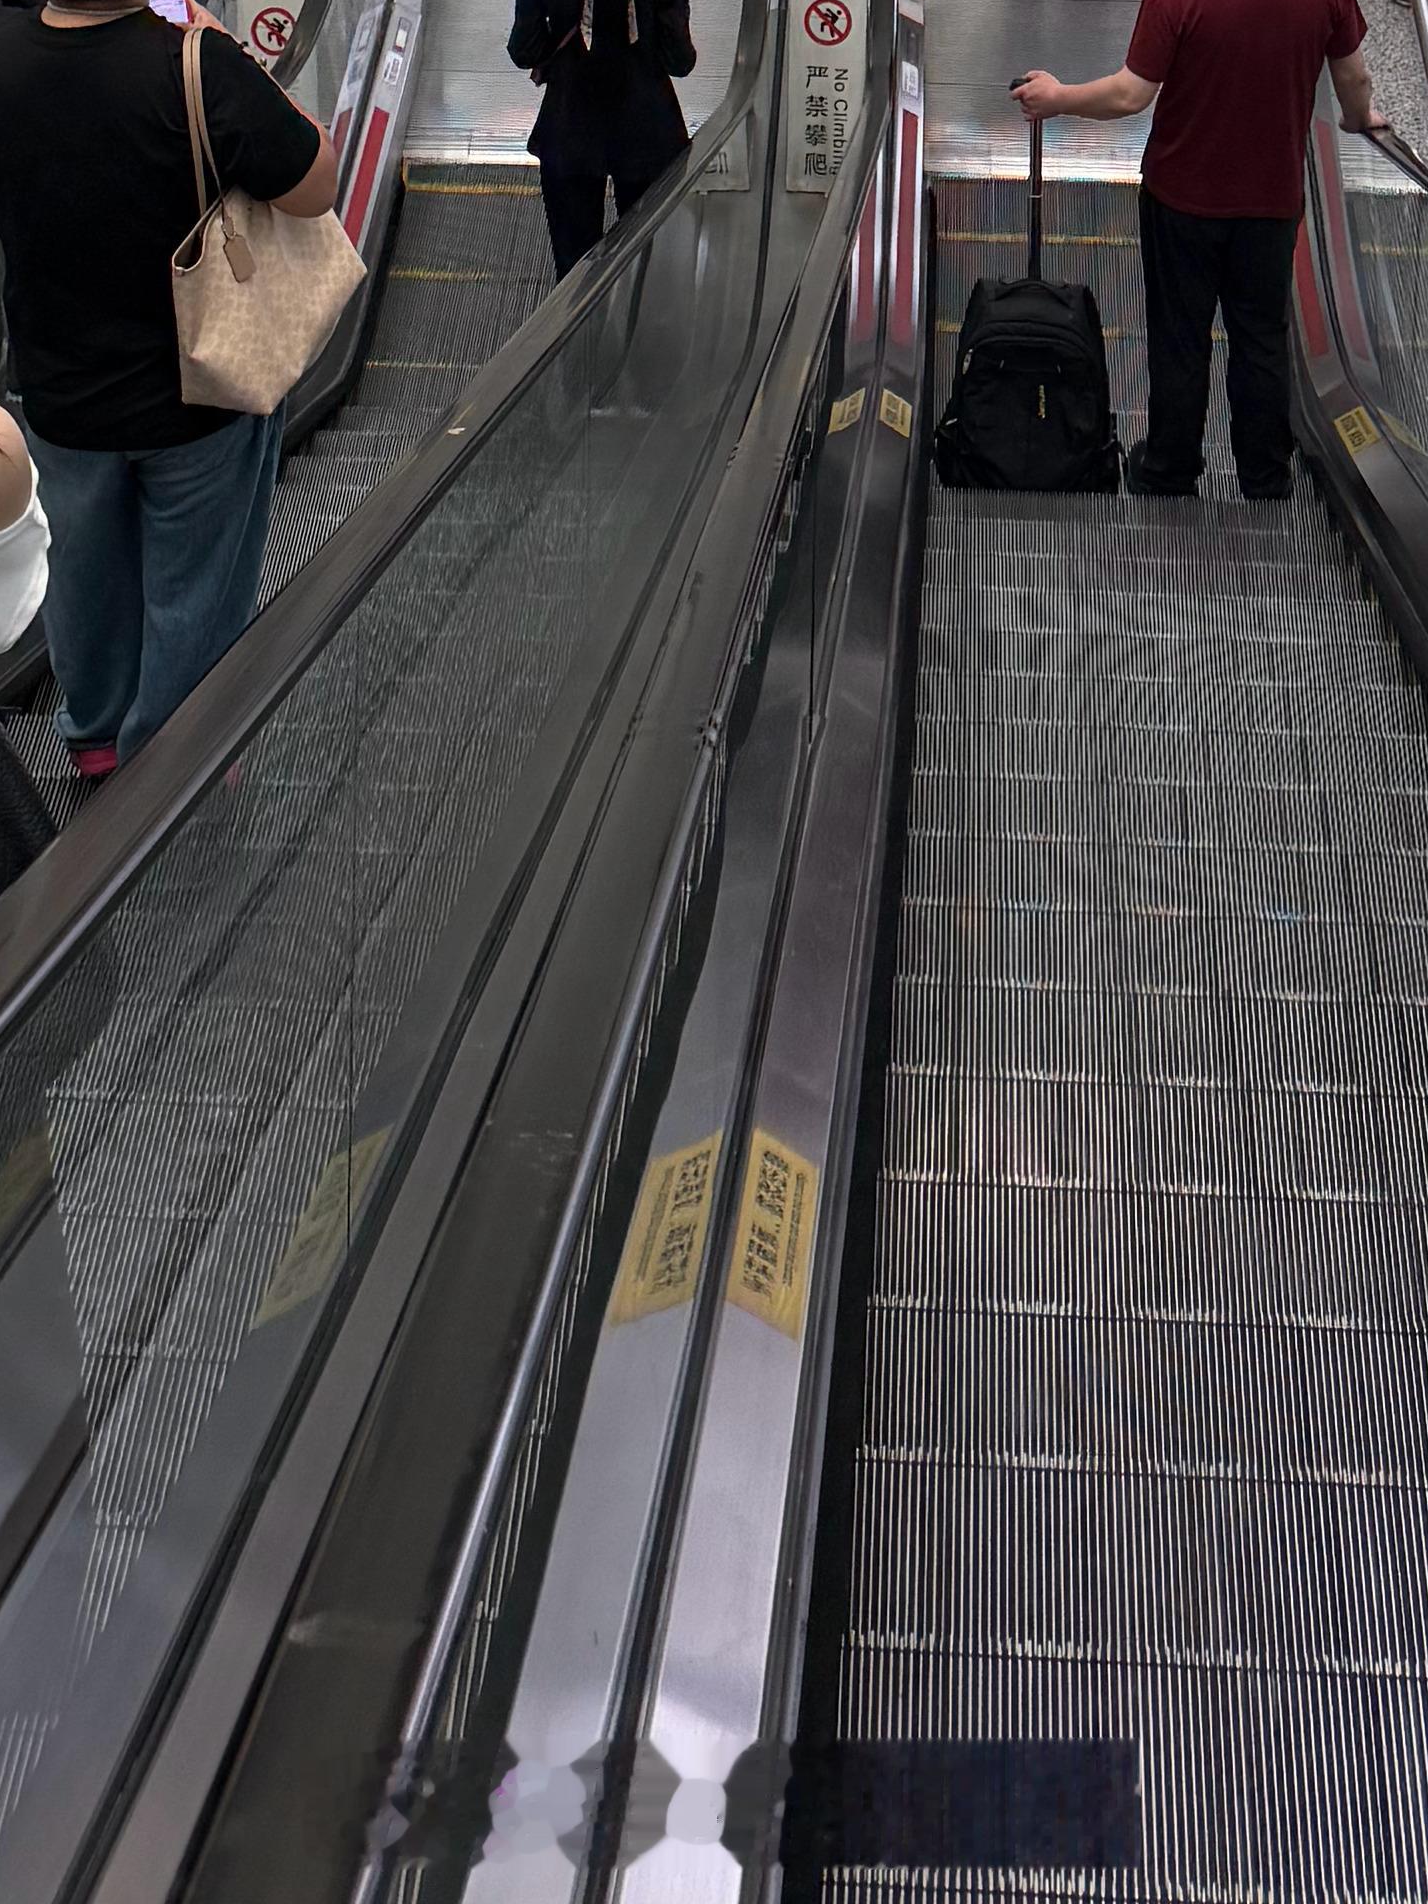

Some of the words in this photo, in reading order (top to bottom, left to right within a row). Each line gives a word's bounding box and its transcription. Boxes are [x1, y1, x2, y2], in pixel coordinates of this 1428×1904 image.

[834, 68, 849, 93] No
[804, 65, 829, 176] 严禁攀爬
